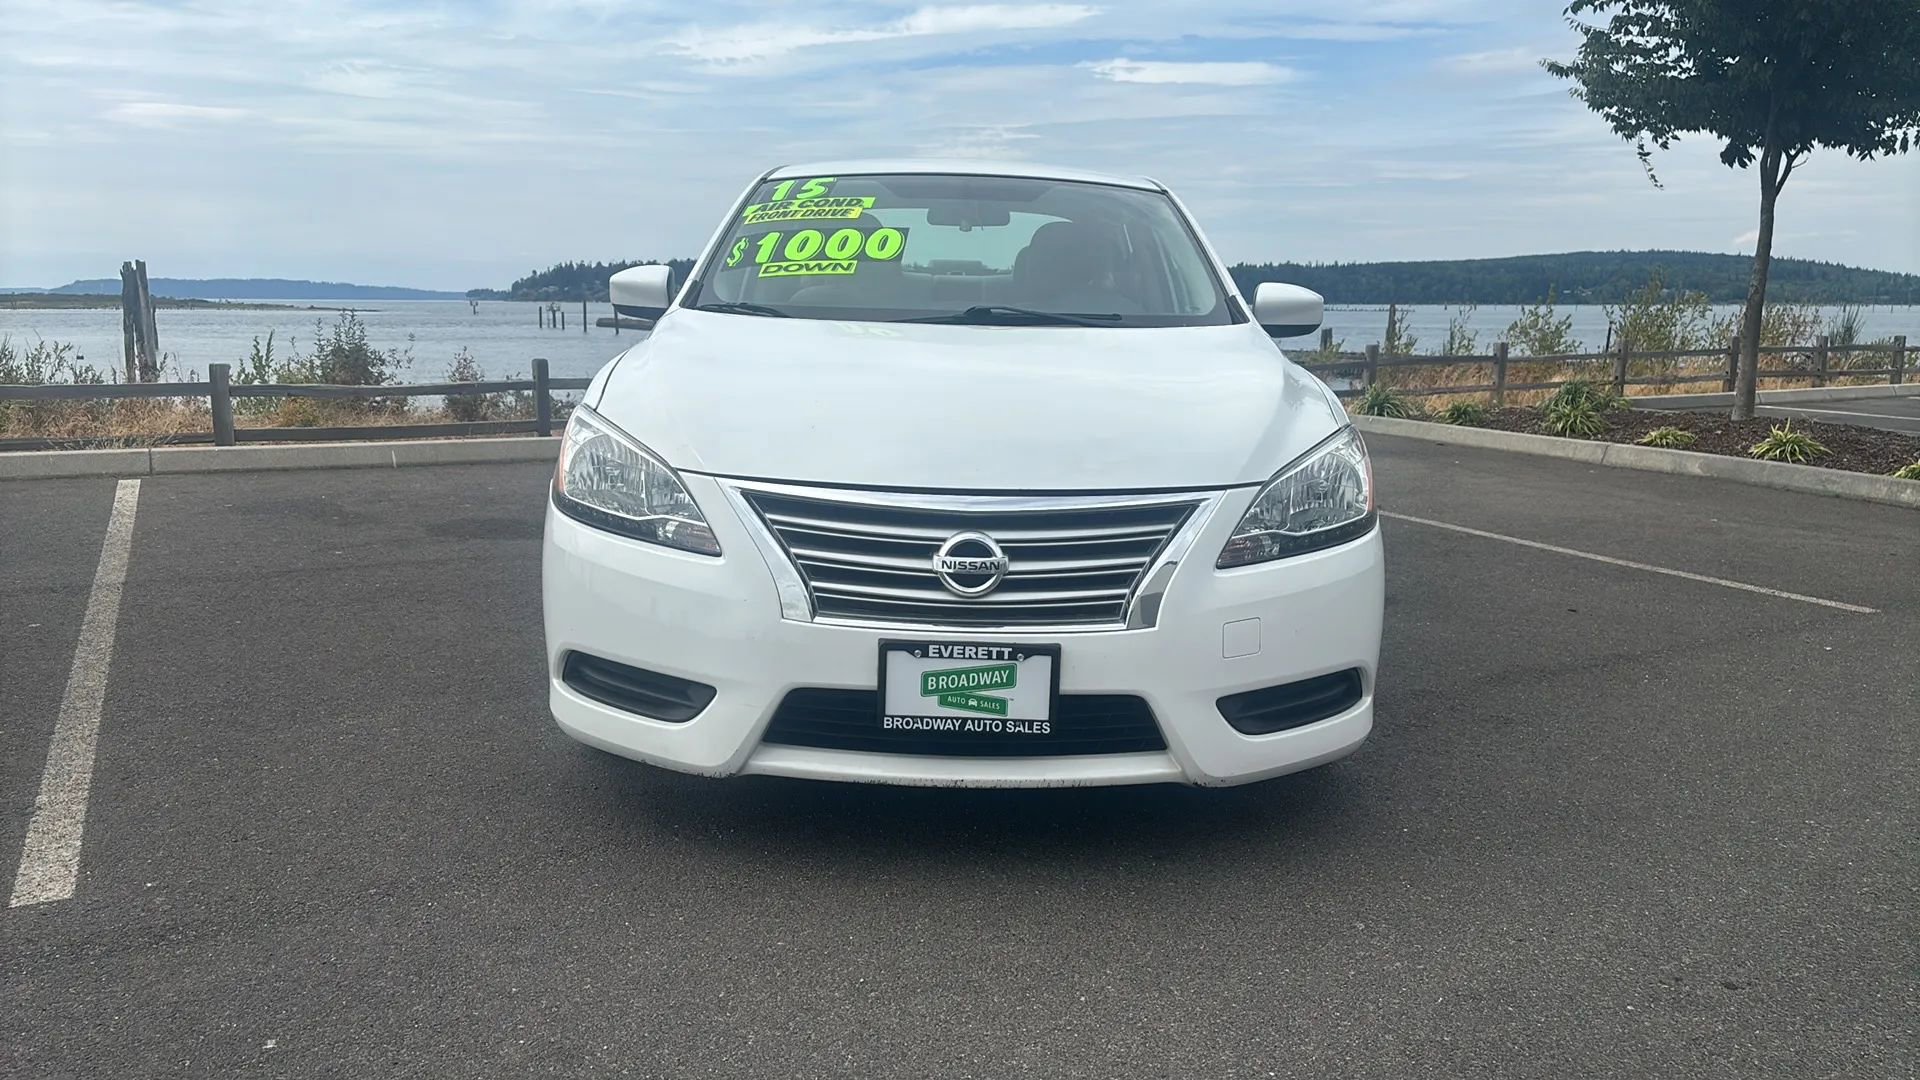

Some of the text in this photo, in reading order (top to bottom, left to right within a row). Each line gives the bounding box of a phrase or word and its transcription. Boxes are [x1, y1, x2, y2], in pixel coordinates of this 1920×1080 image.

[772, 177, 836, 200] 15
[752, 200, 793, 213] AIR
[748, 207, 854, 222] FRONT DRIVE
[762, 262, 852, 274] DOWN
[941, 560, 1000, 570] NISSAN
[928, 644, 1012, 660] EVERETT
[928, 670, 1009, 690] BROADWAY
[947, 695, 1000, 710] AUTO SALES
[883, 717, 1051, 734] BROADWAY AUTO SALES
